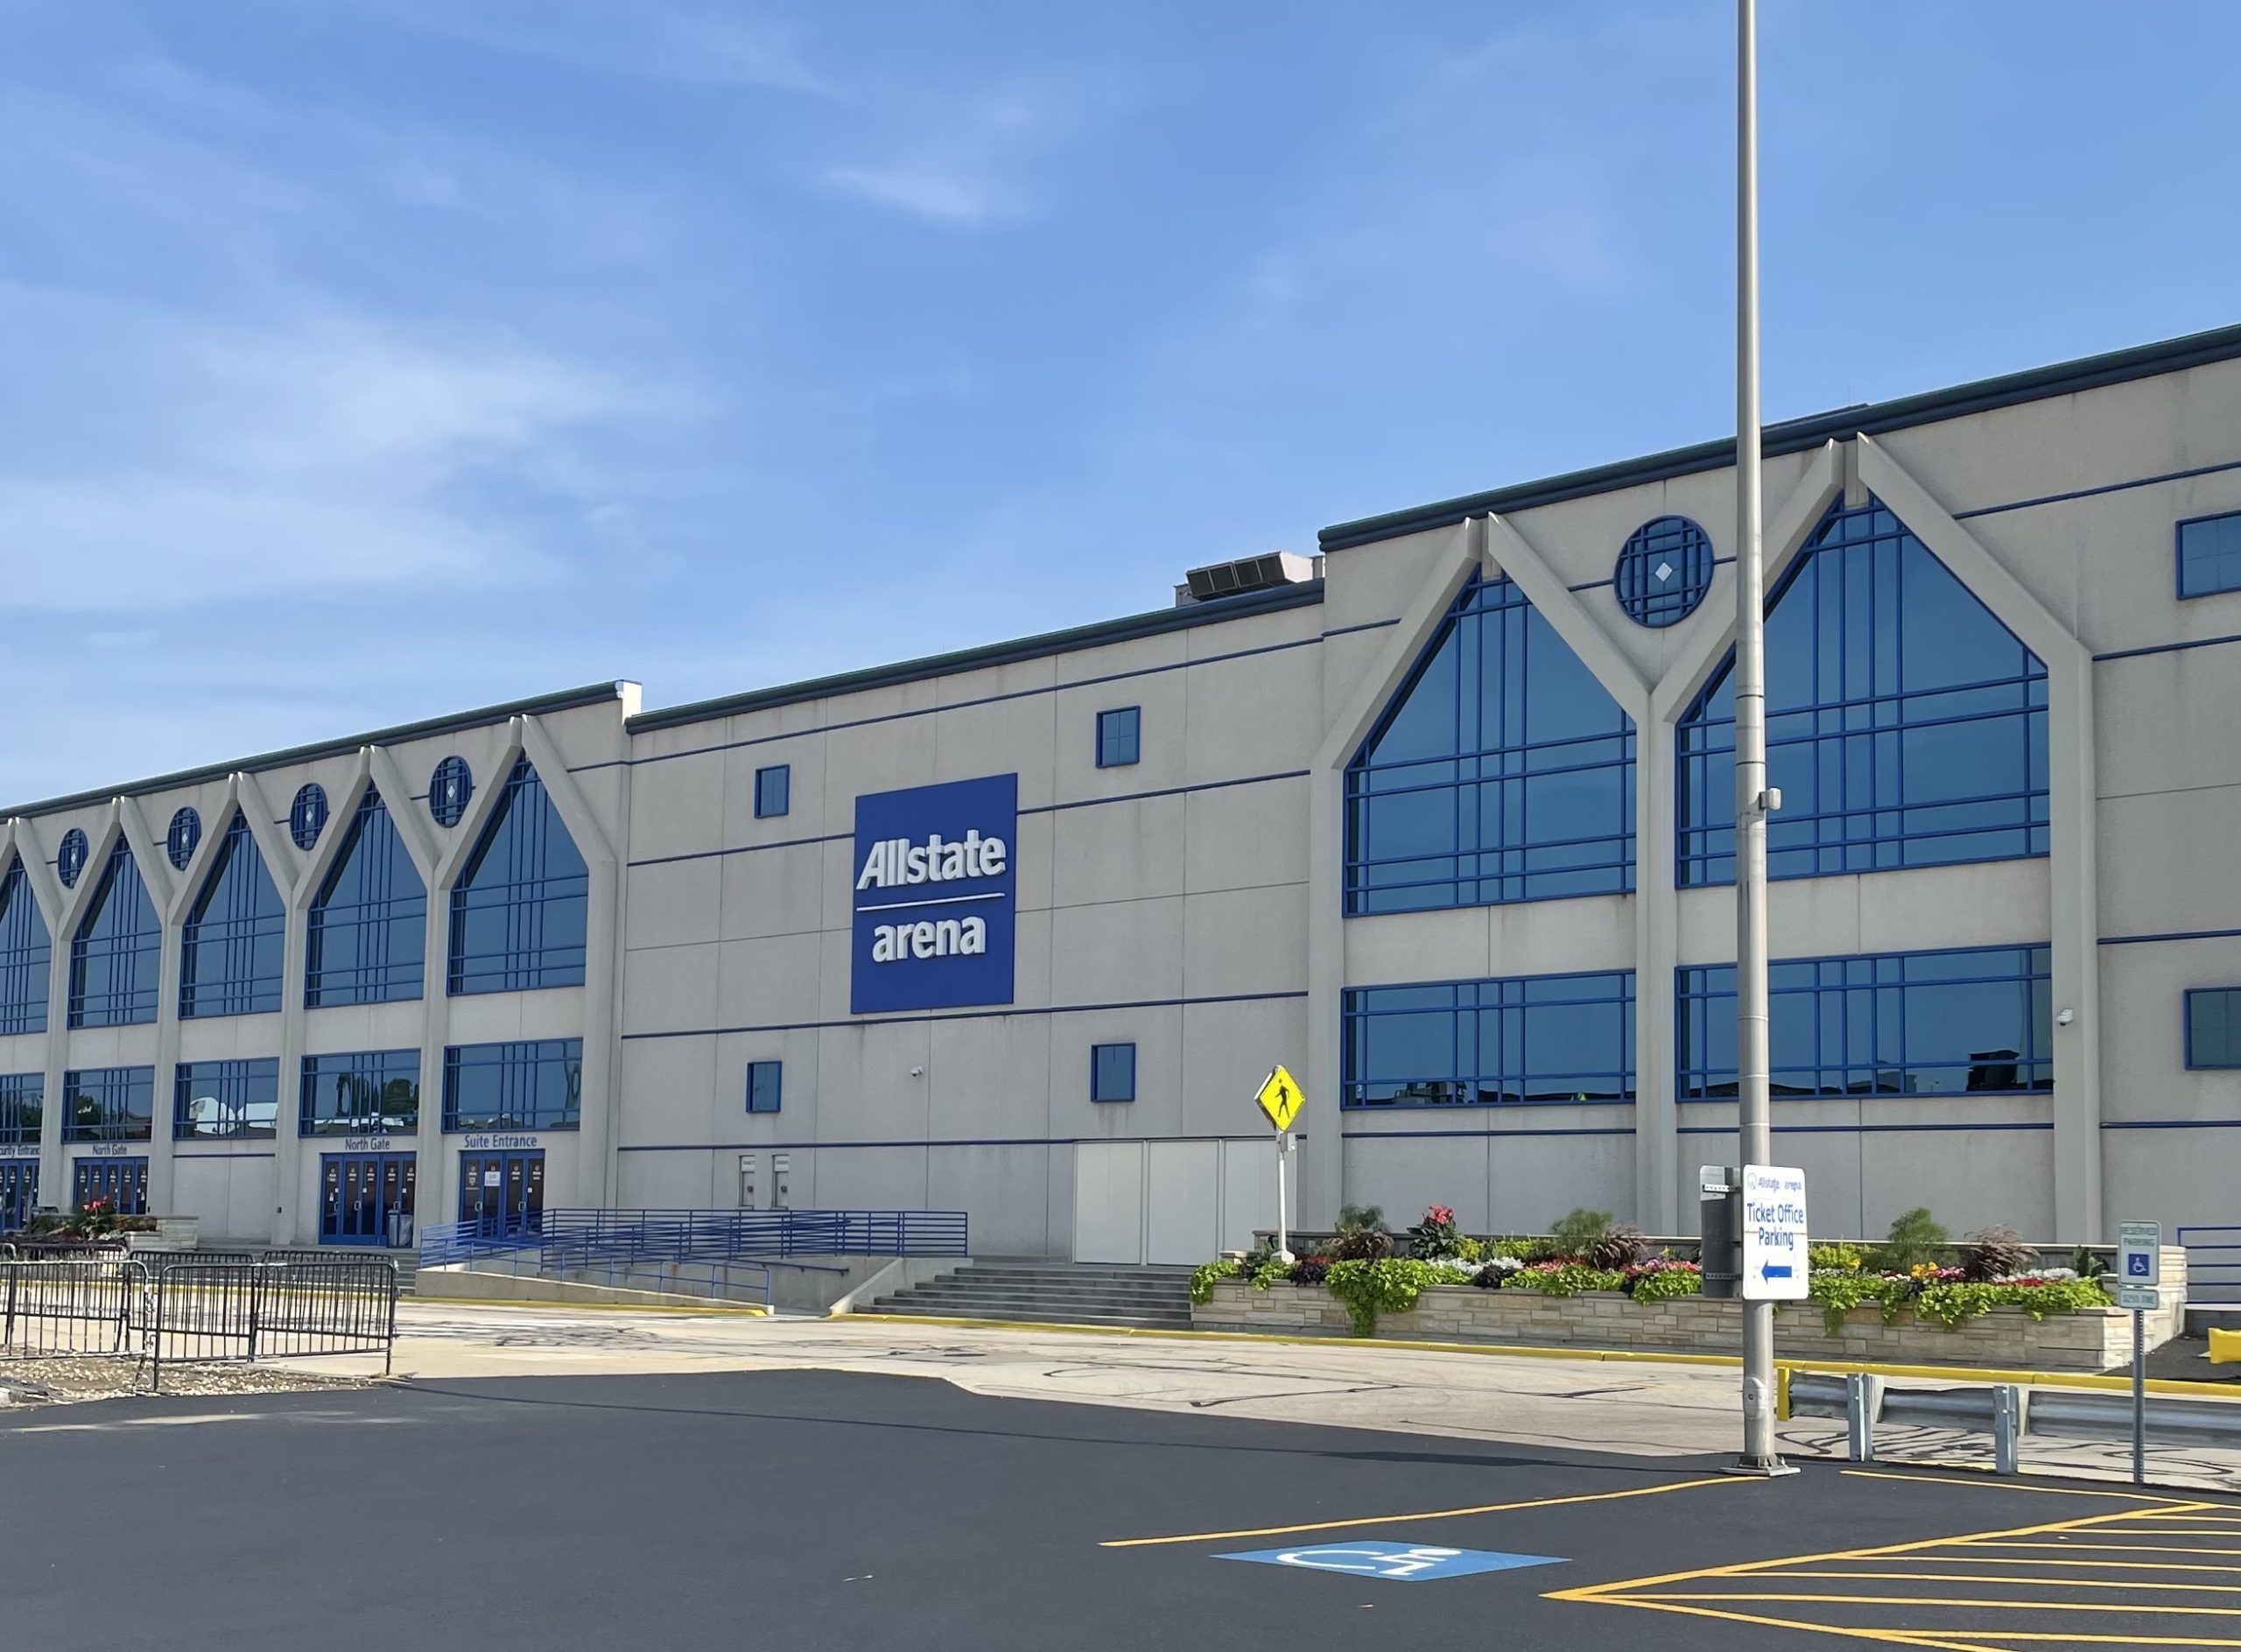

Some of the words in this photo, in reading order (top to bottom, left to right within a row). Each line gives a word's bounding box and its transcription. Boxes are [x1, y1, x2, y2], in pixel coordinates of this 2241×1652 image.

[856, 829, 1006, 890] Allstate
[873, 916, 987, 963] arena
[92, 1143, 111, 1156] North
[112, 1144, 127, 1156] Gate
[345, 1137, 368, 1150] North
[370, 1138, 390, 1150] Gate
[464, 1135, 489, 1148] Suite
[493, 1135, 537, 1148] Entrance
[1746, 1202, 1775, 1223] Ticket
[1778, 1204, 1804, 1224] Office
[1759, 1227, 1794, 1251] Parking
